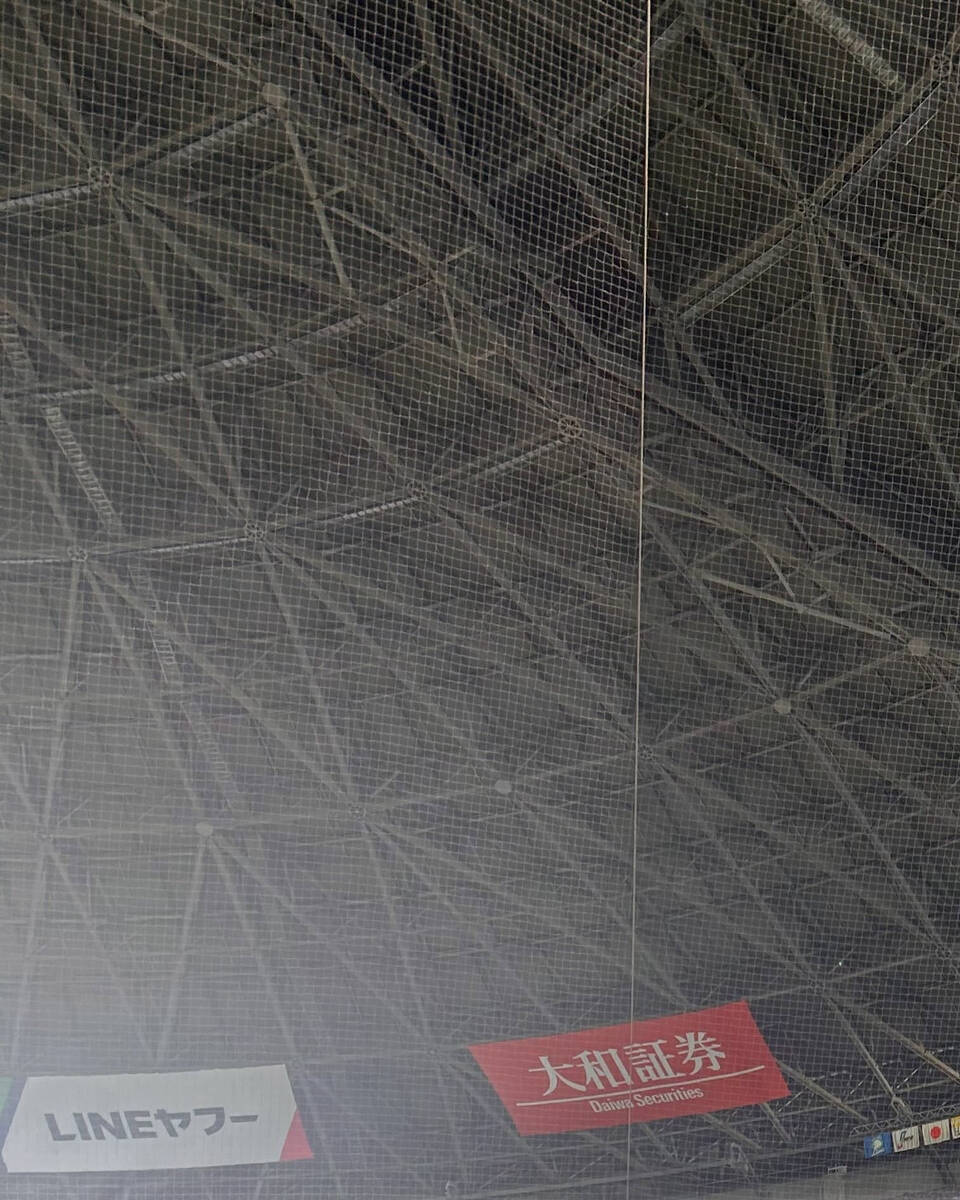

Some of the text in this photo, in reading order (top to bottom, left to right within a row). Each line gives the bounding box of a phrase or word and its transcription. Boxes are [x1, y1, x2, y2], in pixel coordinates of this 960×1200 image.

[528, 1031, 726, 1097] 大和証券
[590, 1086, 704, 1113] Daiwa Securities
[45, 1106, 259, 1142] LINEヤフー
